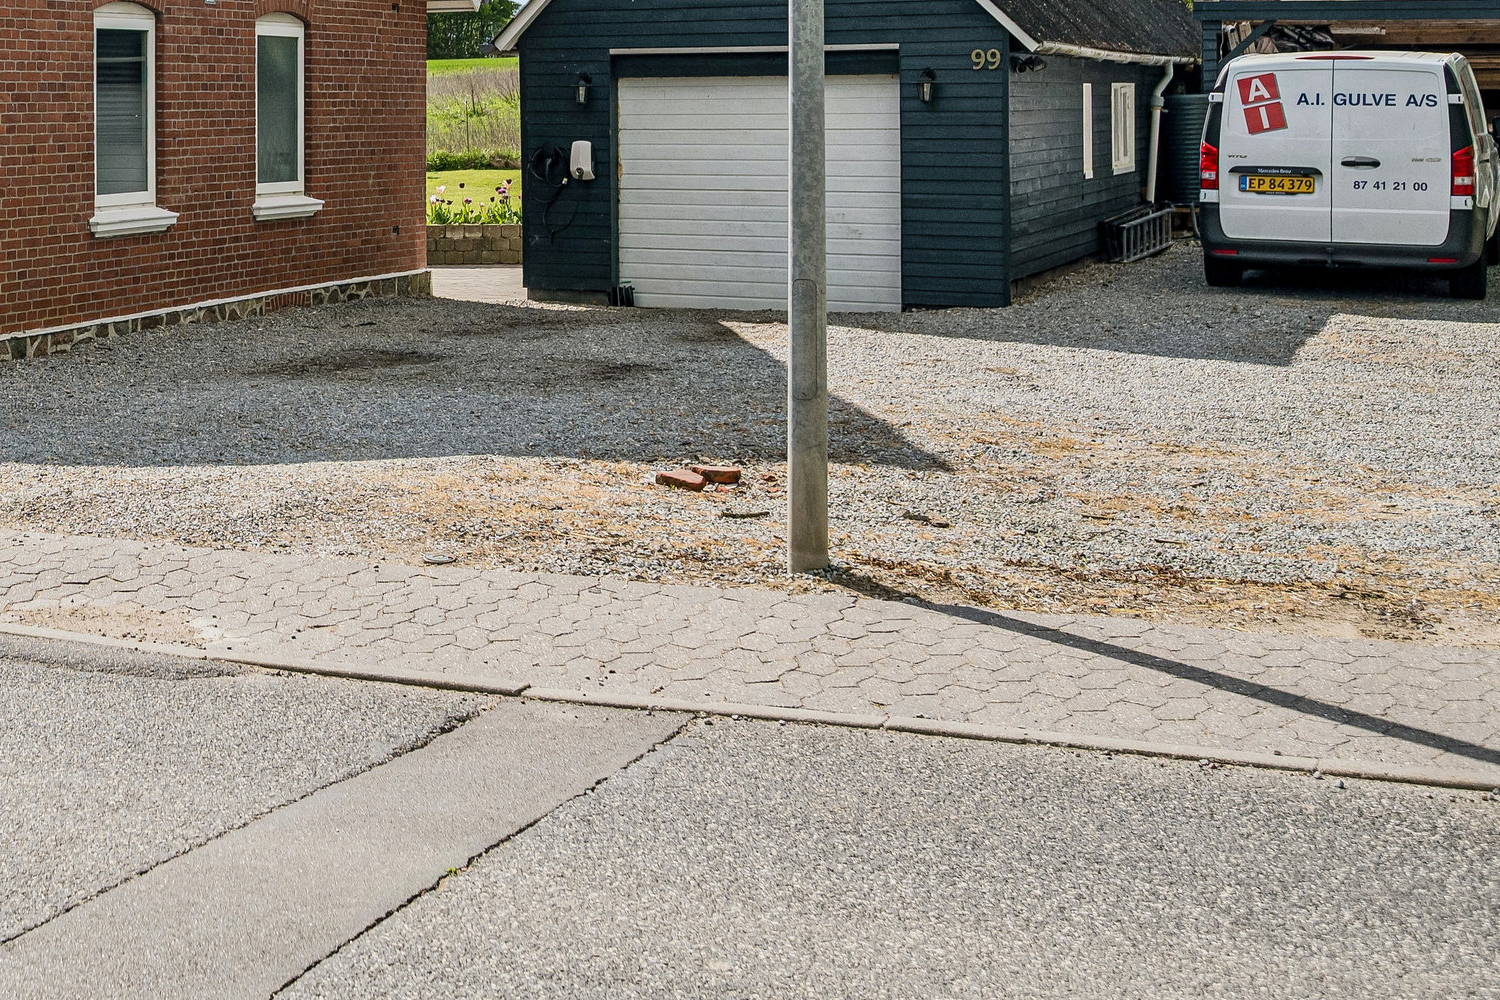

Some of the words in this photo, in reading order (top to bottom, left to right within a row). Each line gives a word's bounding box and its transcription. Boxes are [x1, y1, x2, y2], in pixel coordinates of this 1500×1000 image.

[971, 48, 1001, 70] 99
[1296, 92, 1325, 106] A.I.
[1333, 92, 1397, 107] GULVE
[1405, 93, 1438, 108] A/S
[1248, 178, 1266, 190] EP
[1268, 178, 1285, 191] 84
[1287, 178, 1312, 191] 379
[1353, 180, 1368, 190] 87
[1372, 181, 1386, 191] 41
[1392, 181, 1406, 191] 21
[1412, 182, 1428, 192] 00
